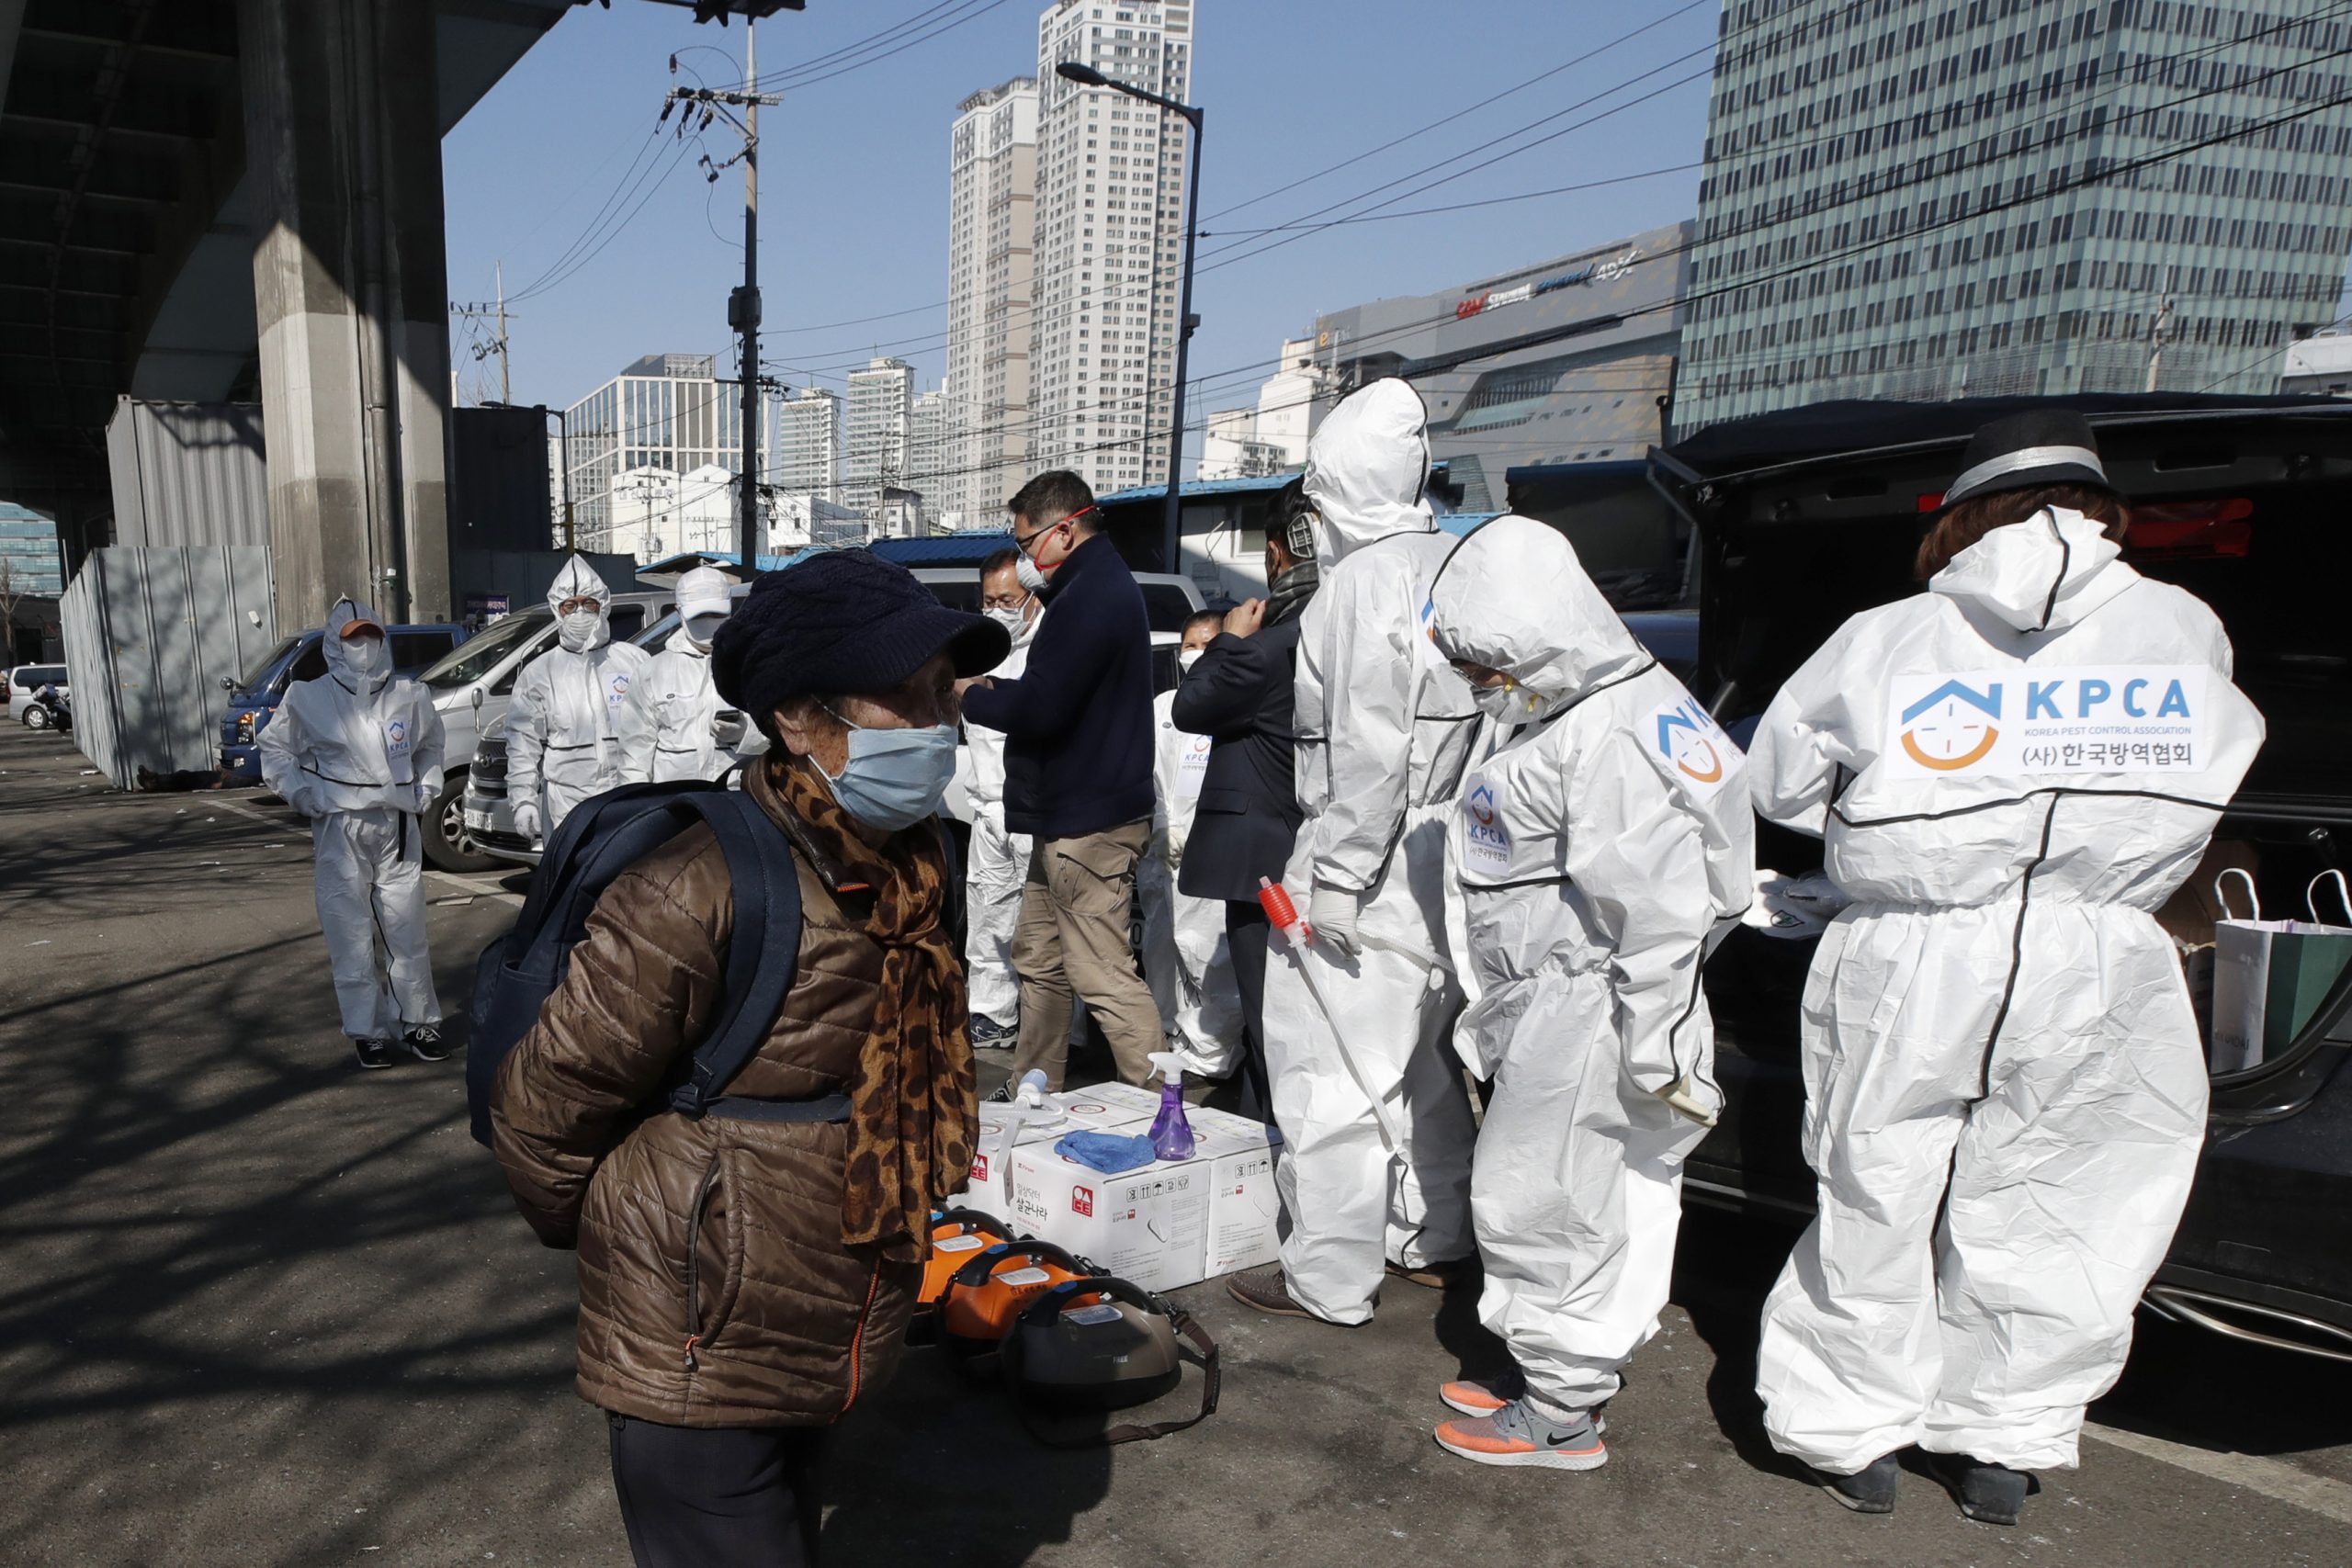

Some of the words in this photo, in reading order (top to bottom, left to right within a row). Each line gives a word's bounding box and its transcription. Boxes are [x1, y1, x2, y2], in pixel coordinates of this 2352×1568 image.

[2026, 678, 2191, 720] KPCA
[2024, 728, 2059, 737] KOREA
[2061, 727, 2086, 736] PEST
[2088, 727, 2132, 735] CONTROL
[2133, 727, 2192, 735] ASSOCIATION
[1470, 824, 1507, 846] KPCA
[1016, 1196, 1048, 1222] 살균나라
